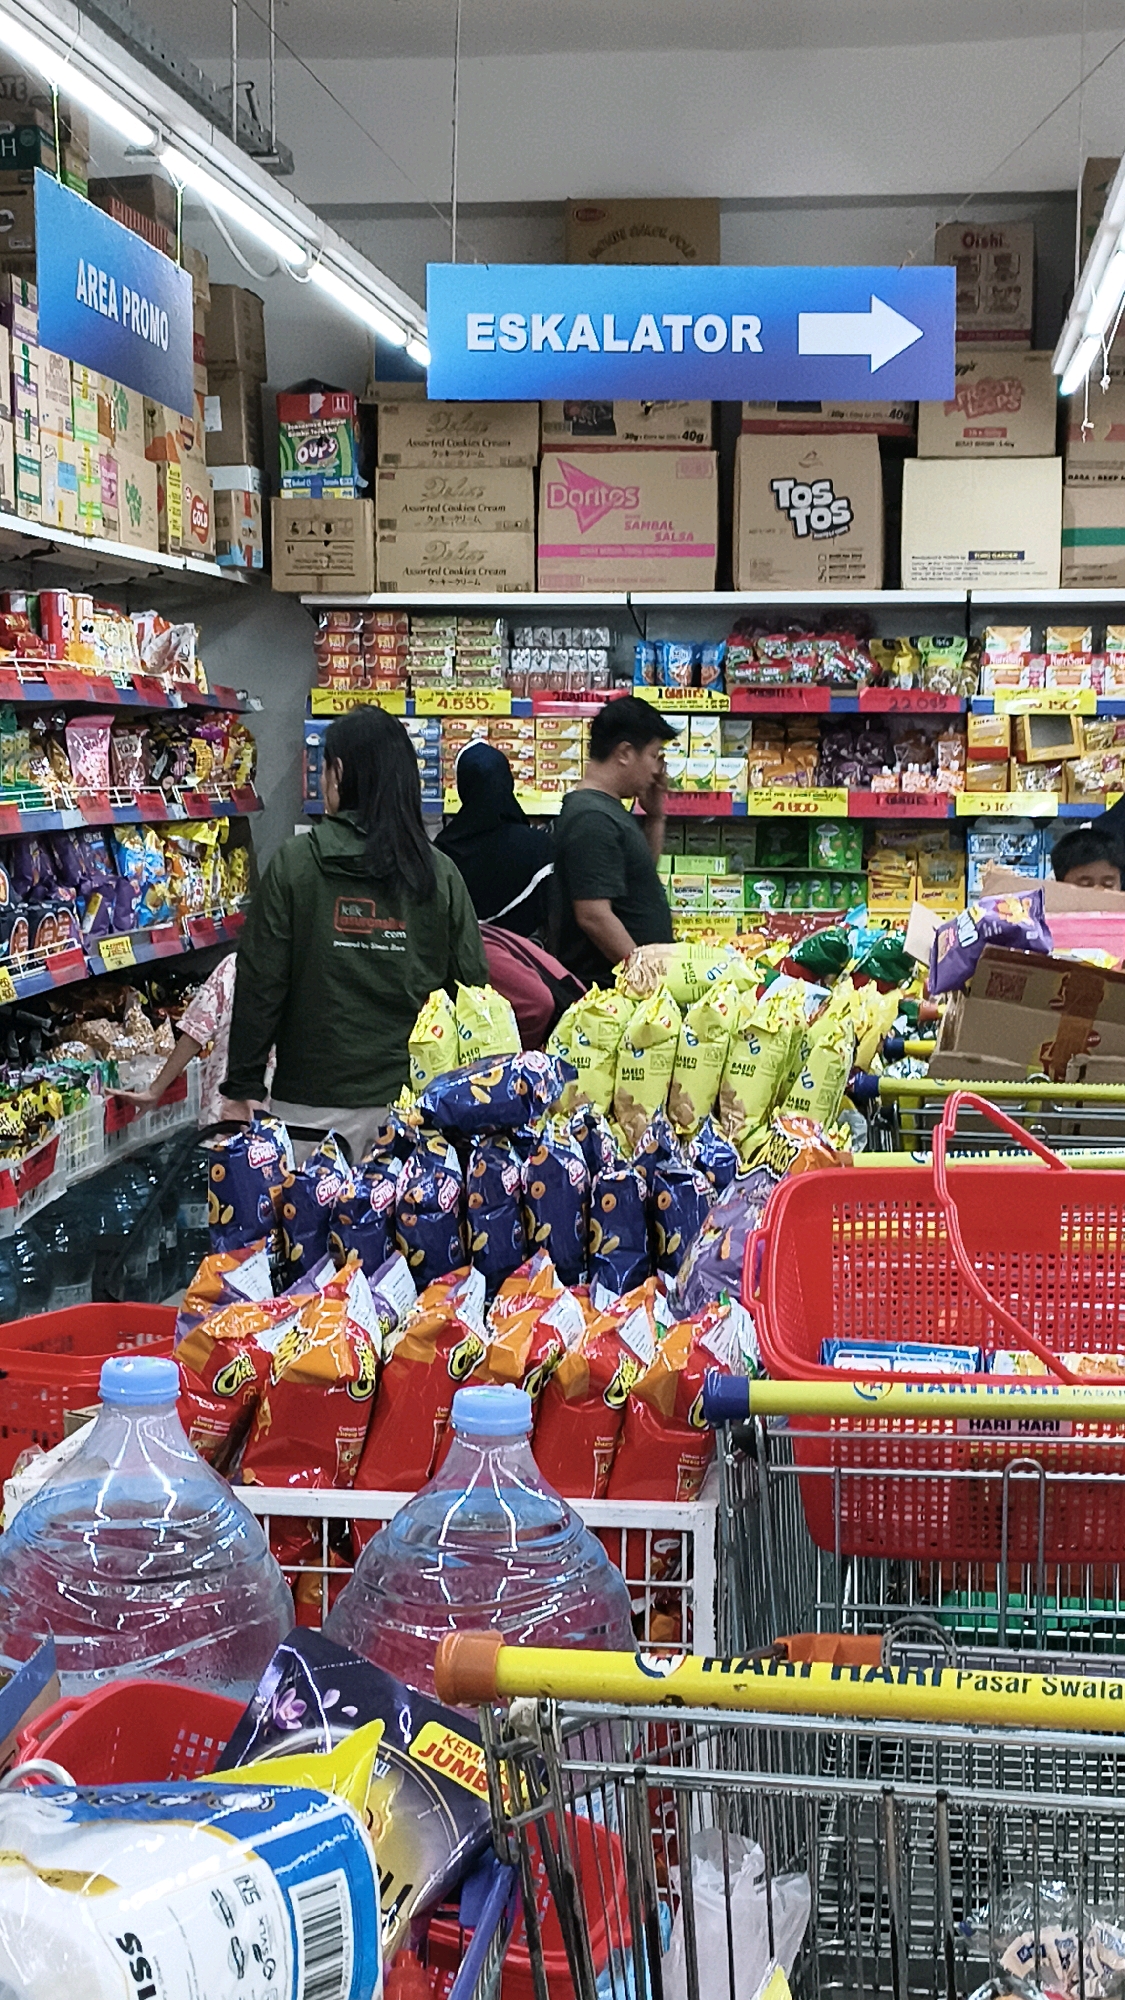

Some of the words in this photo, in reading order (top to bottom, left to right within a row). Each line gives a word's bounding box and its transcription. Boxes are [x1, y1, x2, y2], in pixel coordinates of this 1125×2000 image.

[962, 232, 1004, 249] Oishi
[76, 257, 119, 323] AREA
[121, 284, 169, 352] PROMO
[466, 312, 764, 353] ESKALATOR
[297, 437, 337, 465] OUPS
[548, 485, 640, 509] Doritos
[771, 479, 834, 509] TOS
[401, 503, 440, 514] Assorted
[441, 503, 476, 514] Cookies
[477, 503, 506, 514] Cream
[789, 499, 852, 537] TOS
[624, 521, 674, 531] SAMBAL
[654, 532, 694, 542] SALSA
[402, 567, 441, 577] Assorted
[442, 567, 476, 577] Cookies
[478, 567, 507, 577] Cream
[969, 1419, 1011, 1432] HARI
[1018, 1419, 1060, 1432] HARI
[956, 1671, 1032, 1694] Pasar
